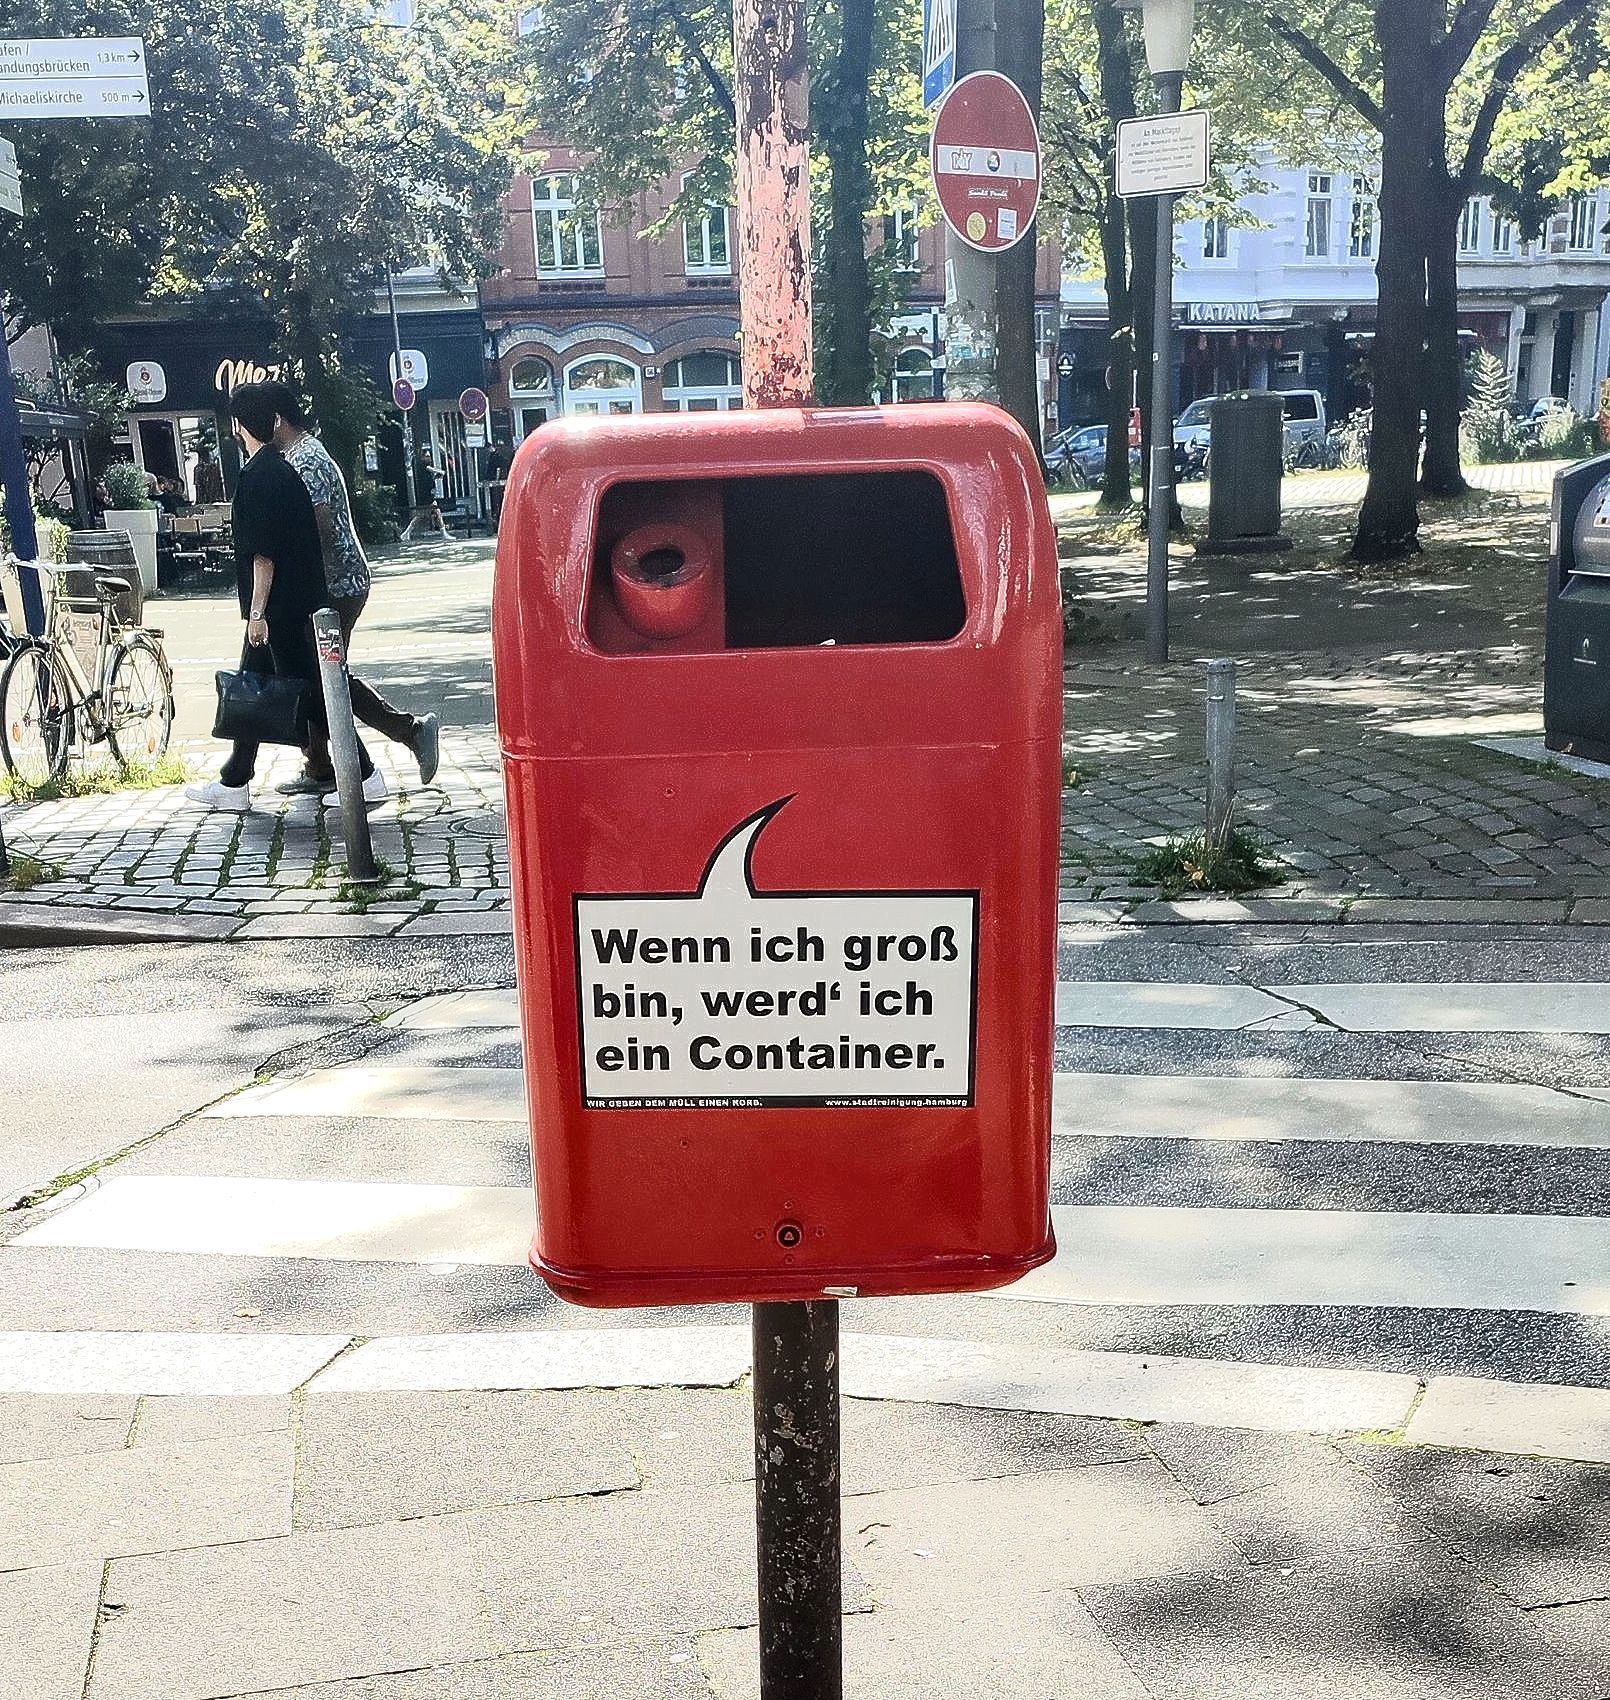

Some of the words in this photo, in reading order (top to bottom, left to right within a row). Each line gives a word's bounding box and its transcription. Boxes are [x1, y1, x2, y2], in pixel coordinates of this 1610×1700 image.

[97, 52, 109, 63] 1,3
[112, 51, 125, 61] km
[101, 92, 118, 102] 500
[121, 94, 130, 102] m
[1190, 303, 1260, 320] KATANA
[591, 928, 731, 964] Wenn
[750, 927, 825, 963] ich
[843, 925, 959, 971] groß
[592, 983, 684, 1026] bin,
[859, 981, 933, 1016] ich
[595, 1036, 671, 1071] ein
[689, 1035, 946, 1071] Container.
[586, 1099, 606, 1108] WIR
[608, 1099, 642, 1107] GEBEN
[645, 1099, 666, 1107] DEM
[668, 1098, 696, 1107] MÜLL
[699, 1099, 729, 1107] EINEN
[732, 1099, 763, 1107] KORB.
[825, 1098, 968, 1107] www.stadtreinigung.hamburg
